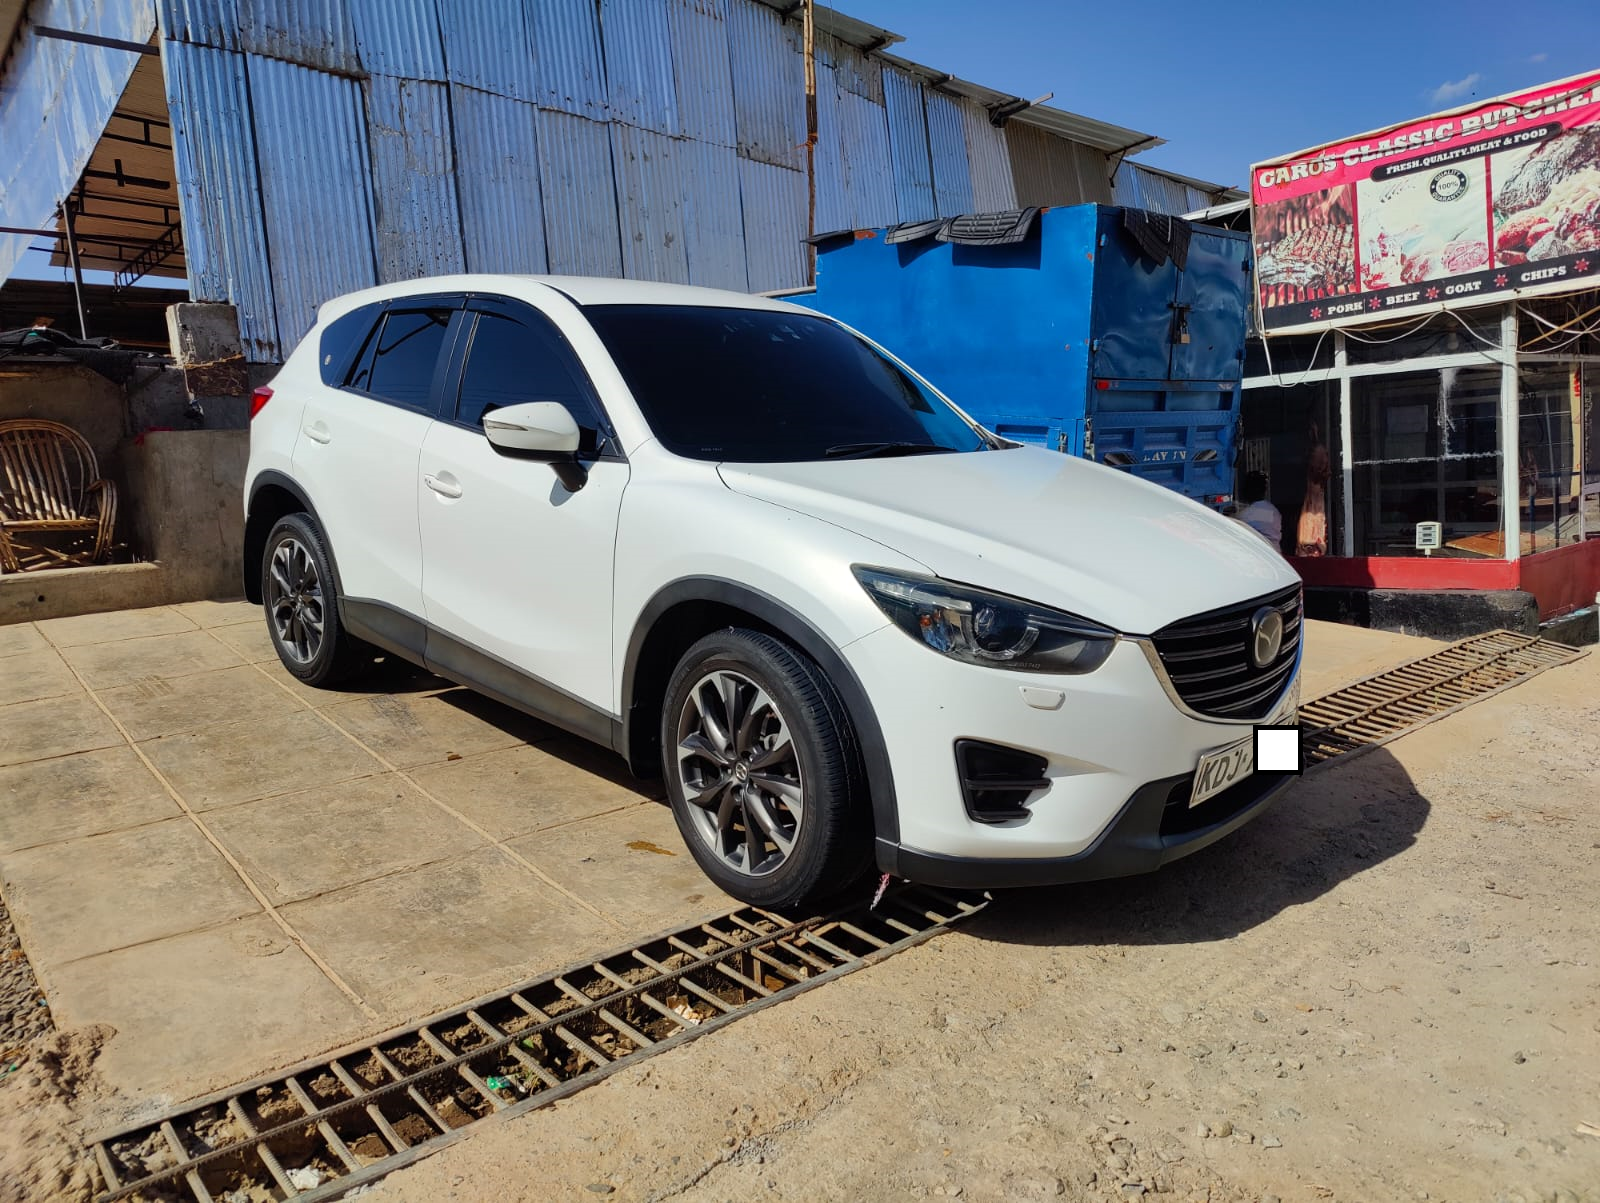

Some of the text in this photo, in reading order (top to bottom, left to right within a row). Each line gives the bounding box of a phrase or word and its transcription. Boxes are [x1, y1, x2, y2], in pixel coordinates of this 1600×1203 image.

[1343, 122, 1454, 166] CLASSIC
[1503, 137, 1513, 146] &
[1514, 128, 1548, 143] FOOD
[1438, 180, 1459, 191] 100%
[1327, 265, 1567, 315] PORK BEEF GOAT CHIPS
